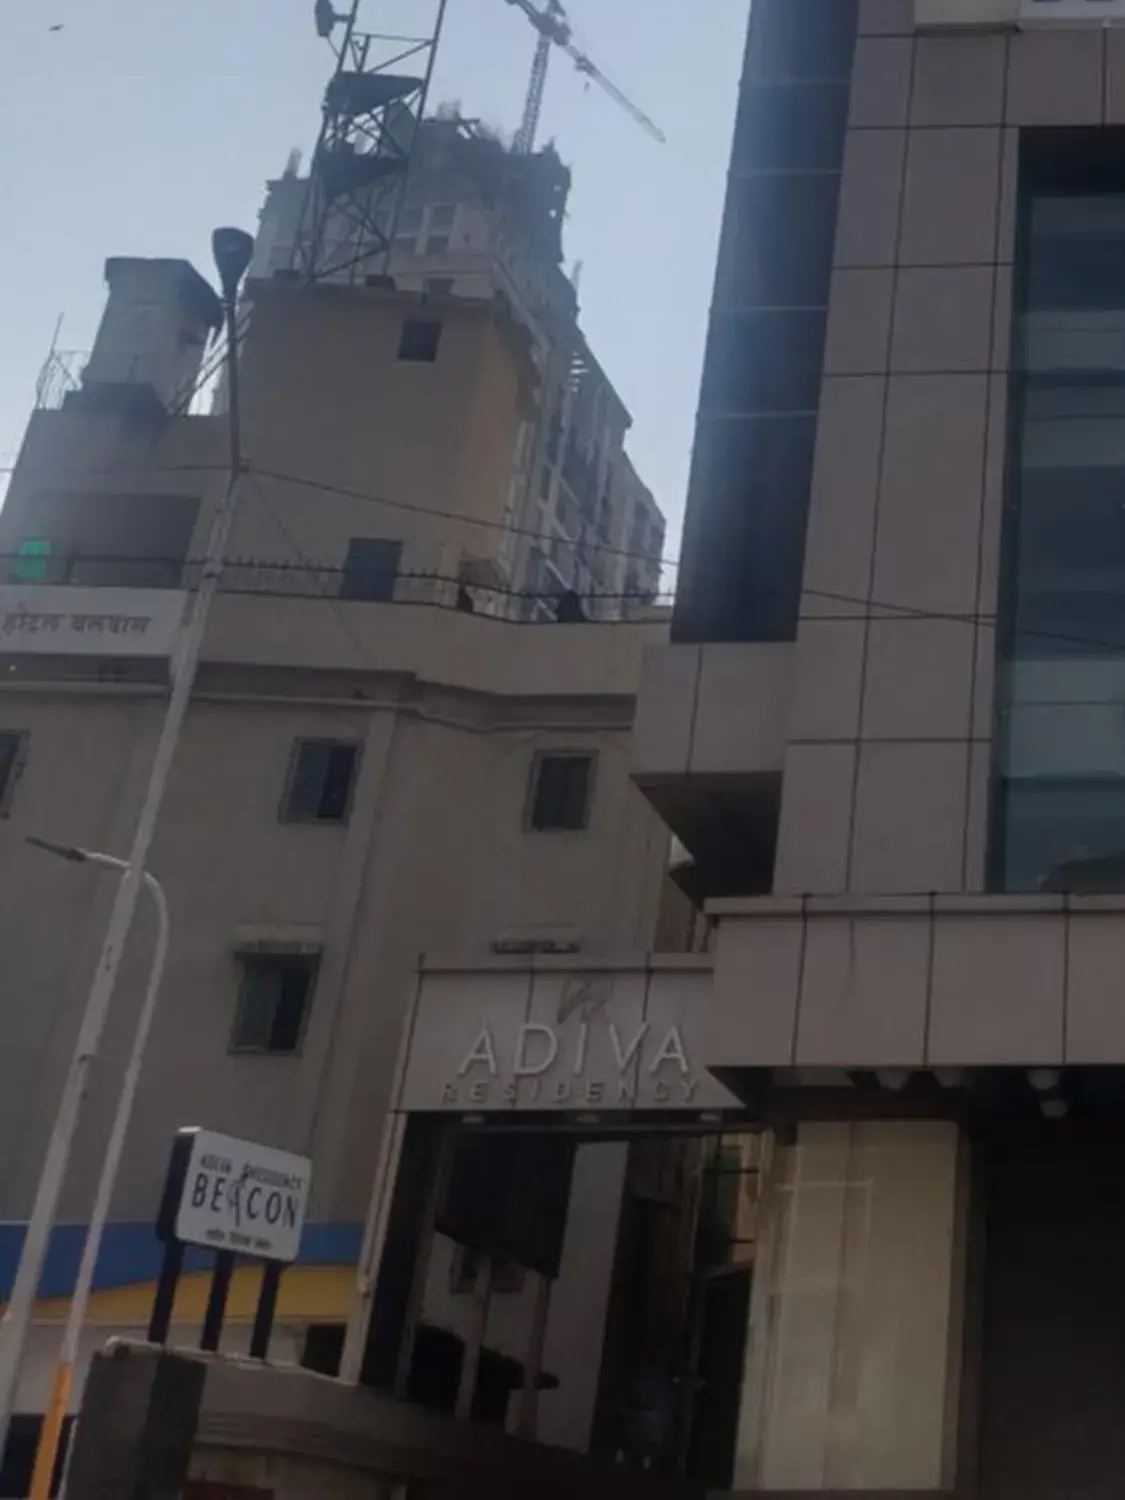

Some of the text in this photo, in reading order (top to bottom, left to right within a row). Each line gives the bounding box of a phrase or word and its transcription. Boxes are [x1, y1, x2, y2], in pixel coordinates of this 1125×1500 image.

[456, 1020, 689, 1077] ADIVA
[441, 1079, 699, 1104] RESIDENCY
[191, 1172, 299, 1229] BEACON
